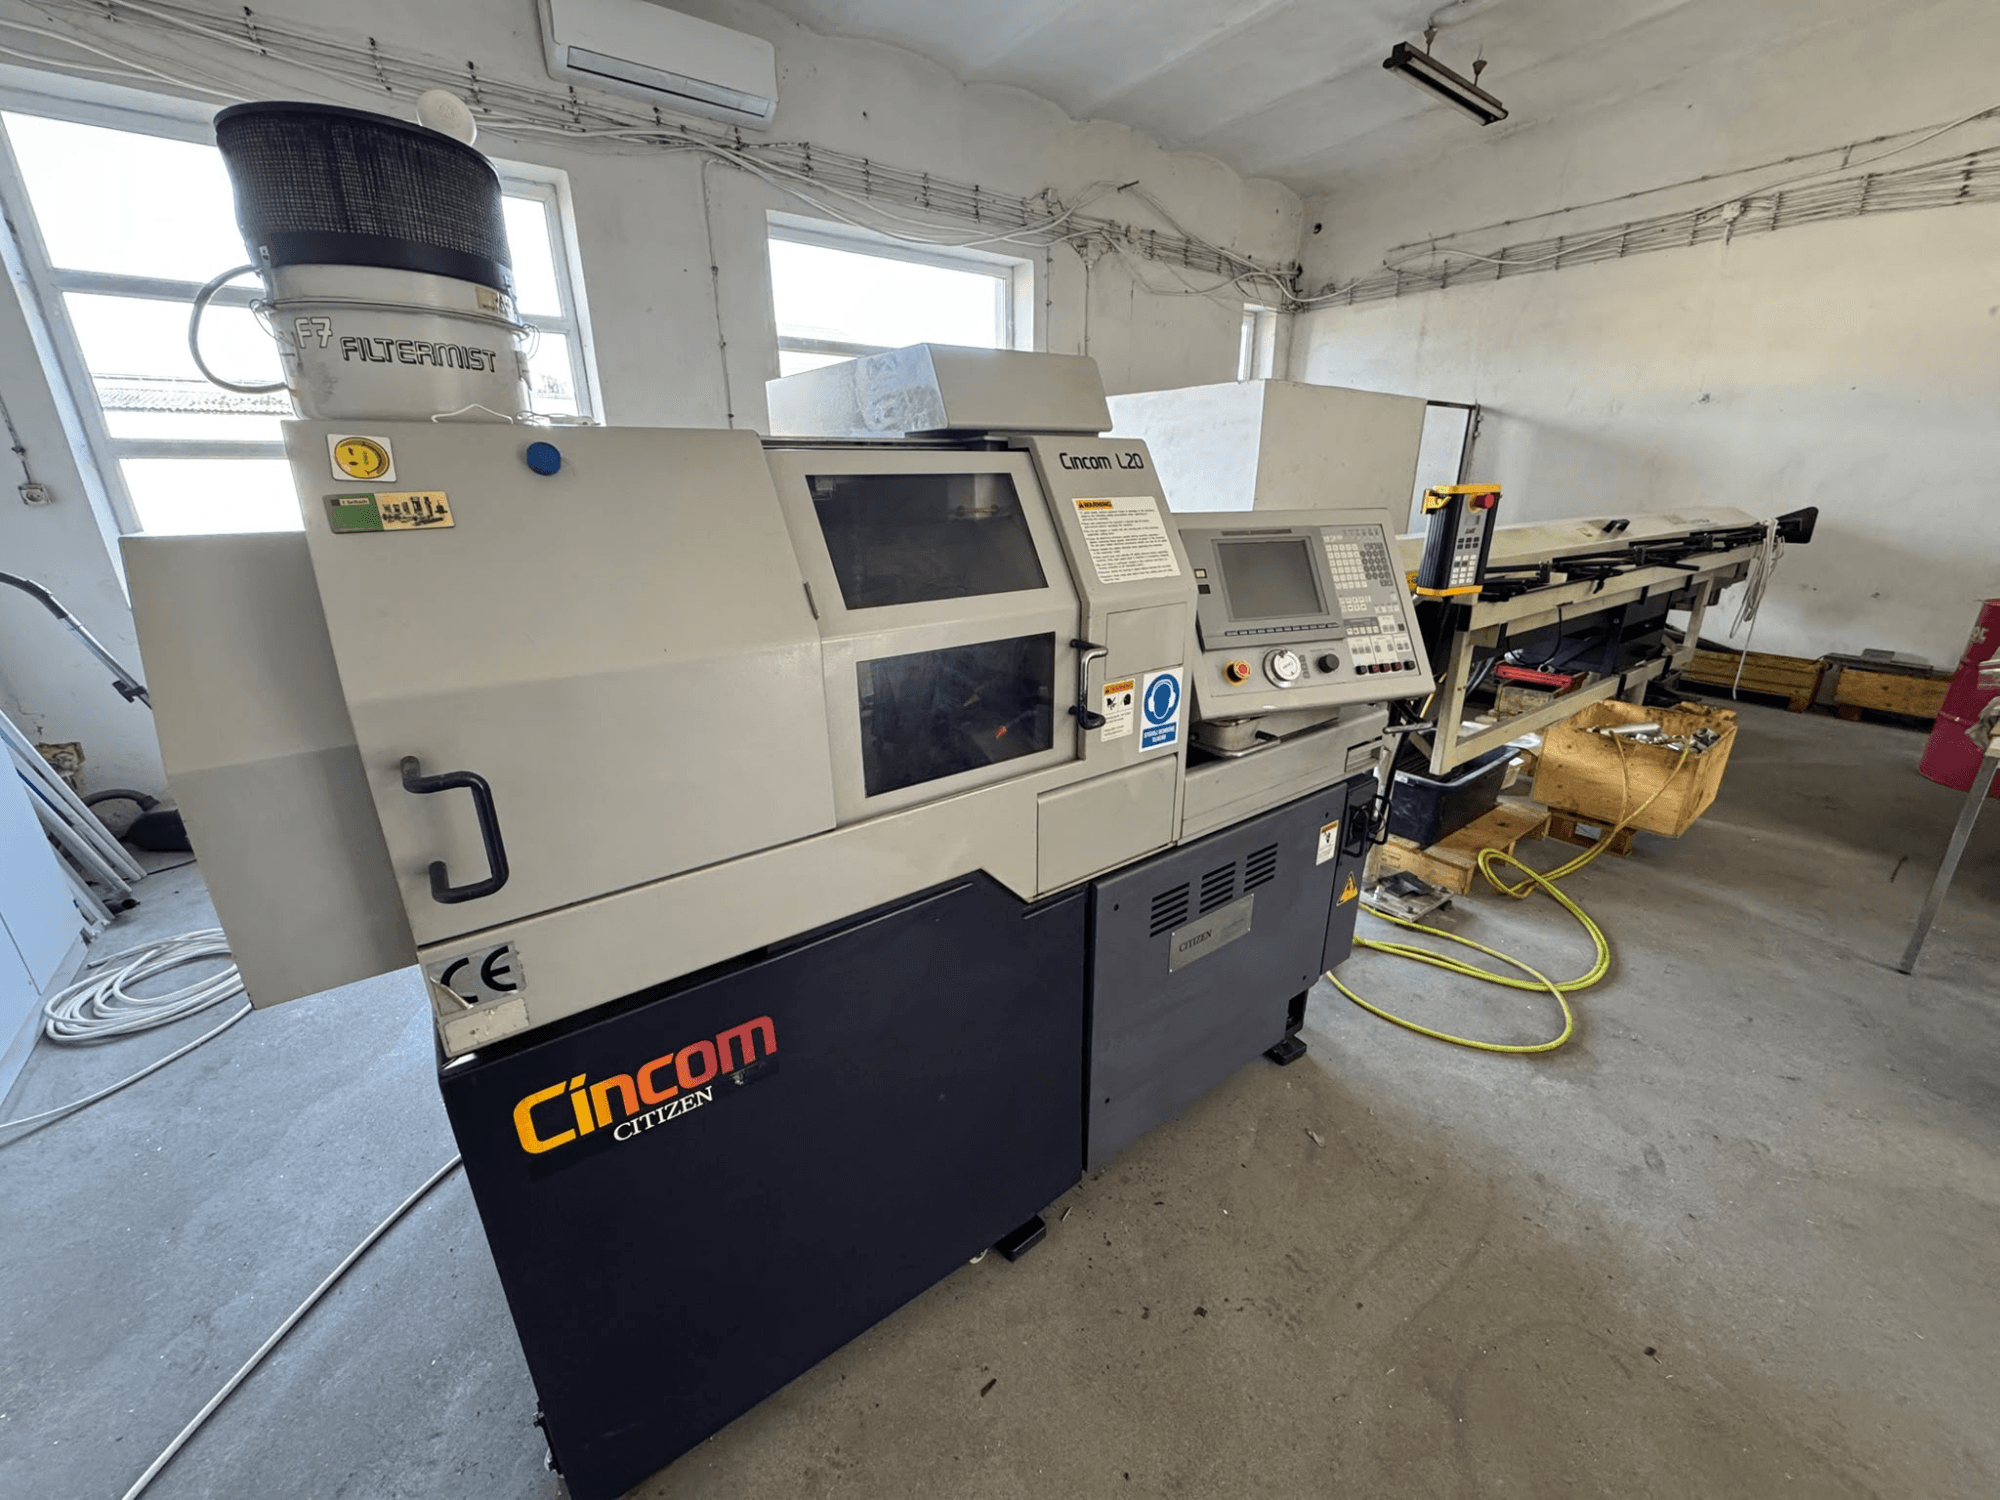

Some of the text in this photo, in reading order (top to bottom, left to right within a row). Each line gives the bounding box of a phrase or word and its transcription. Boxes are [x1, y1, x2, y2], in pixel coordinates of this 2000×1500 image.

[294, 316, 333, 349] F7
[340, 336, 496, 373] FILTERMIST
[1059, 452, 1145, 470] Cincom L20
[1083, 500, 1112, 508] WARNING
[1179, 929, 1212, 953] CITIZEN
[440, 945, 517, 1004] CE
[513, 1015, 778, 1155] Cincom
[613, 1085, 715, 1142] CITIZEN
